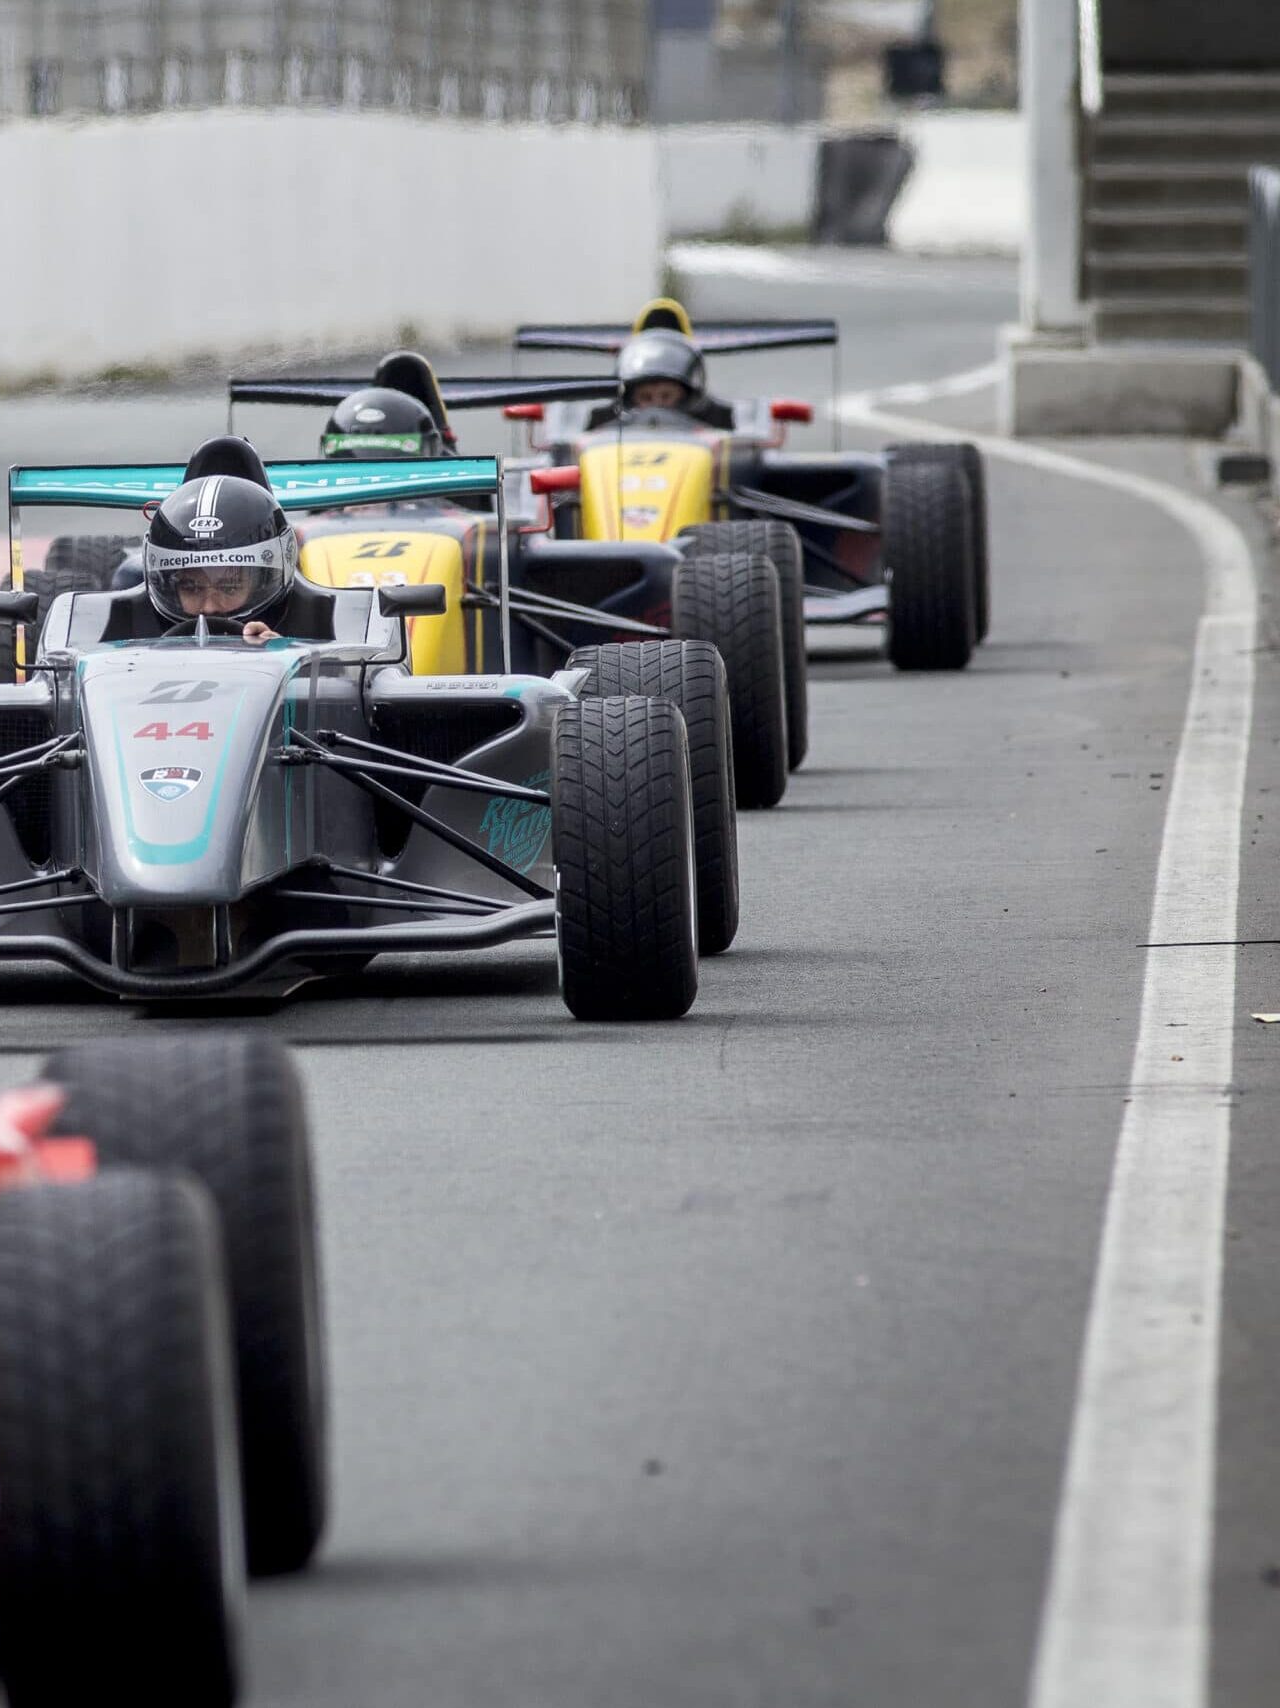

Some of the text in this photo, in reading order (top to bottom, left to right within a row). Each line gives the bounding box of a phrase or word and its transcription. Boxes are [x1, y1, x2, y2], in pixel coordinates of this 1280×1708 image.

[190, 518, 220, 529] JEXX
[160, 553, 256, 568] raceplanet.com
[132, 721, 215, 741] 44
